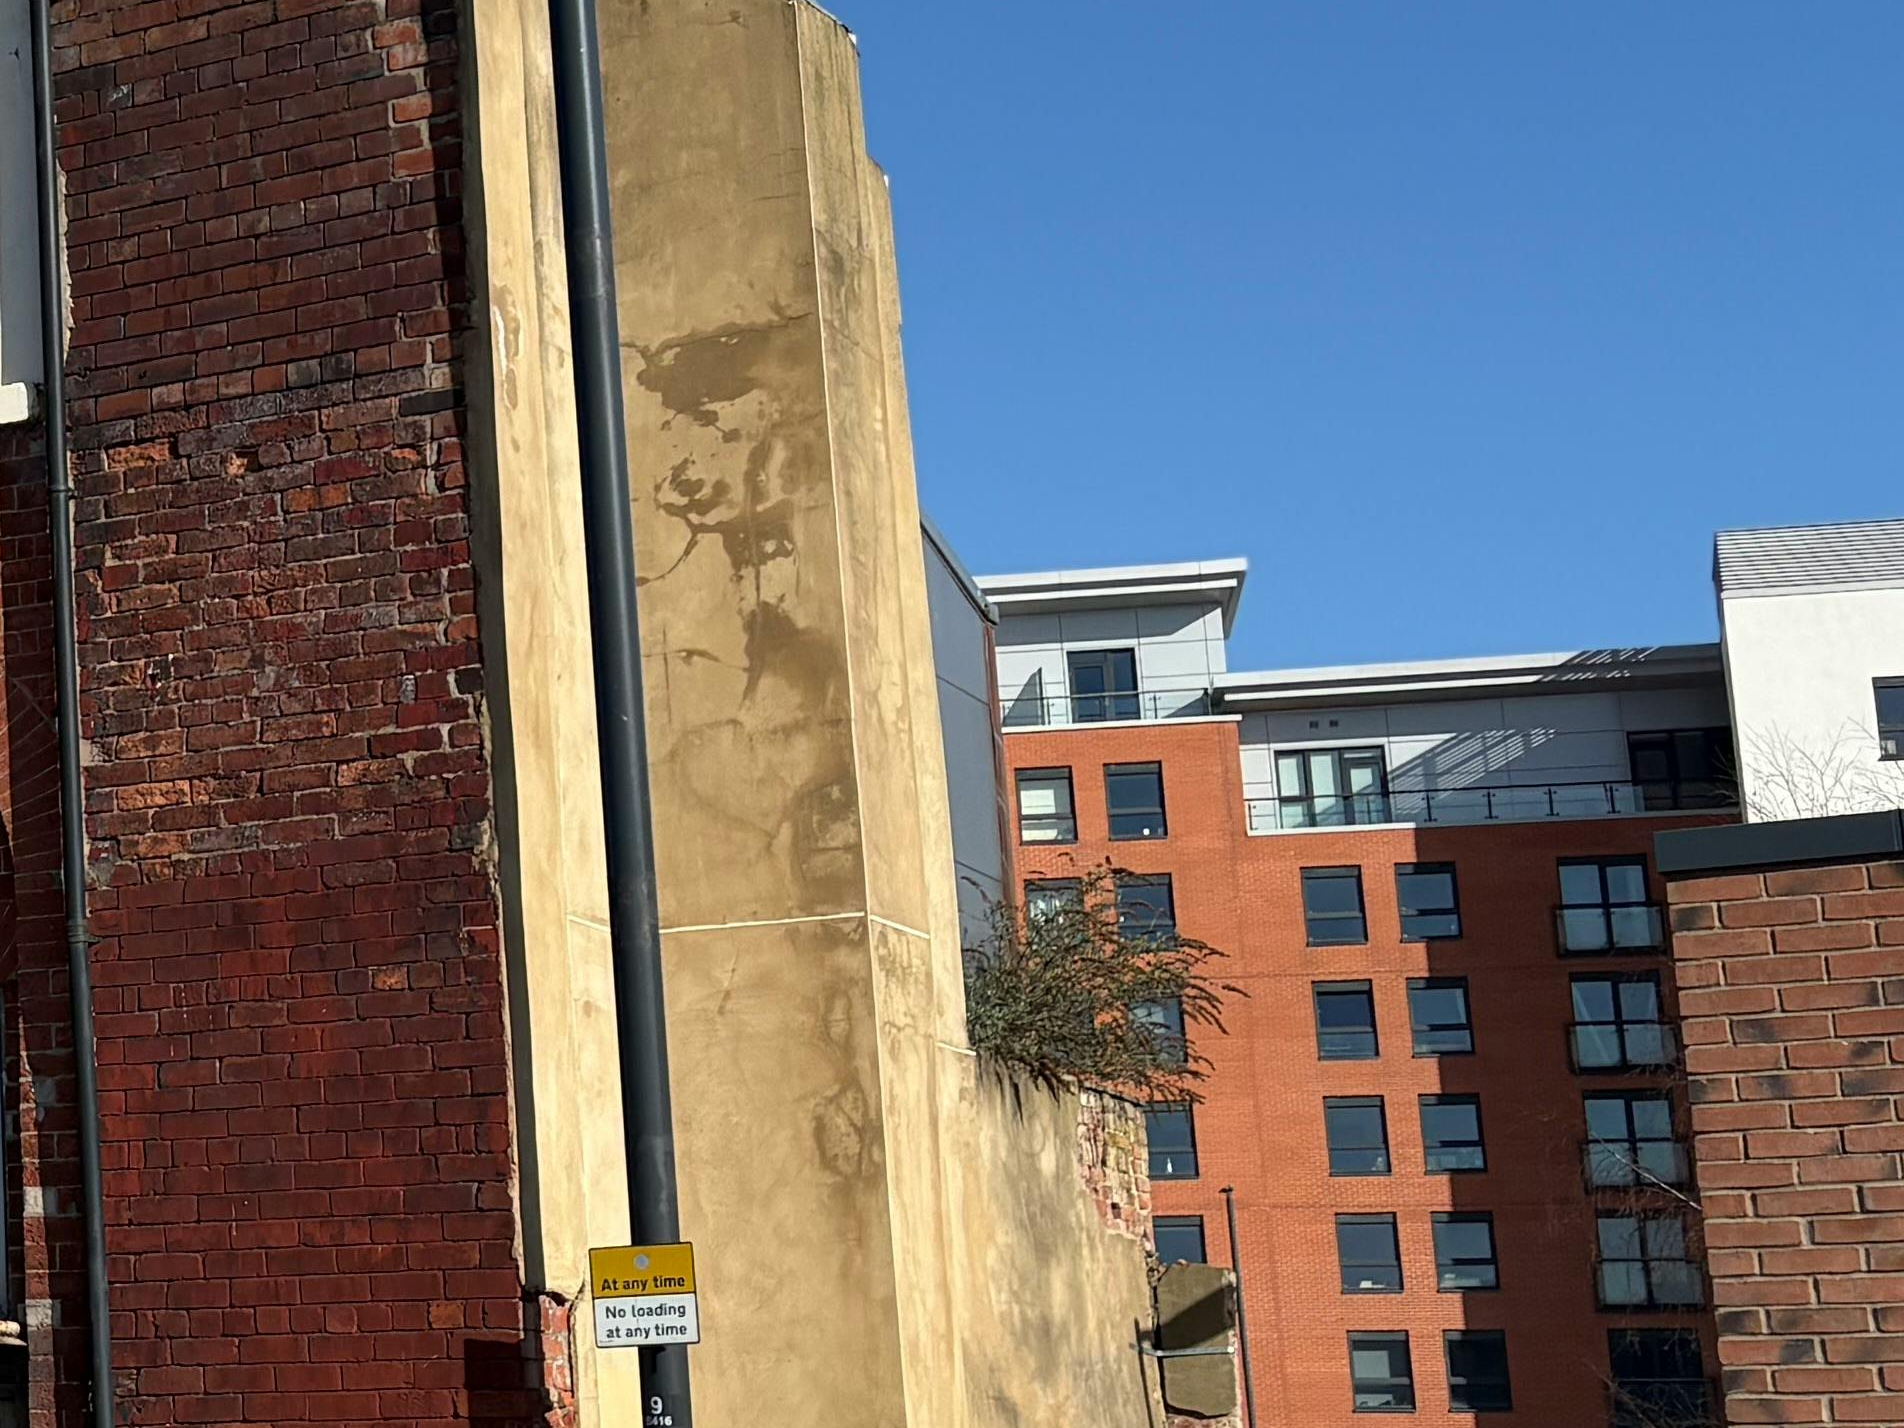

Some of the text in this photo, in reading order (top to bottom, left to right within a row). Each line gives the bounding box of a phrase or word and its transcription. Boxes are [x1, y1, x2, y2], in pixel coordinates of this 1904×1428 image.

[601, 1275, 685, 1292] At any time
[605, 1302, 686, 1319] No loading
[606, 1323, 687, 1340] at any time
[650, 1396, 663, 1415] 9
